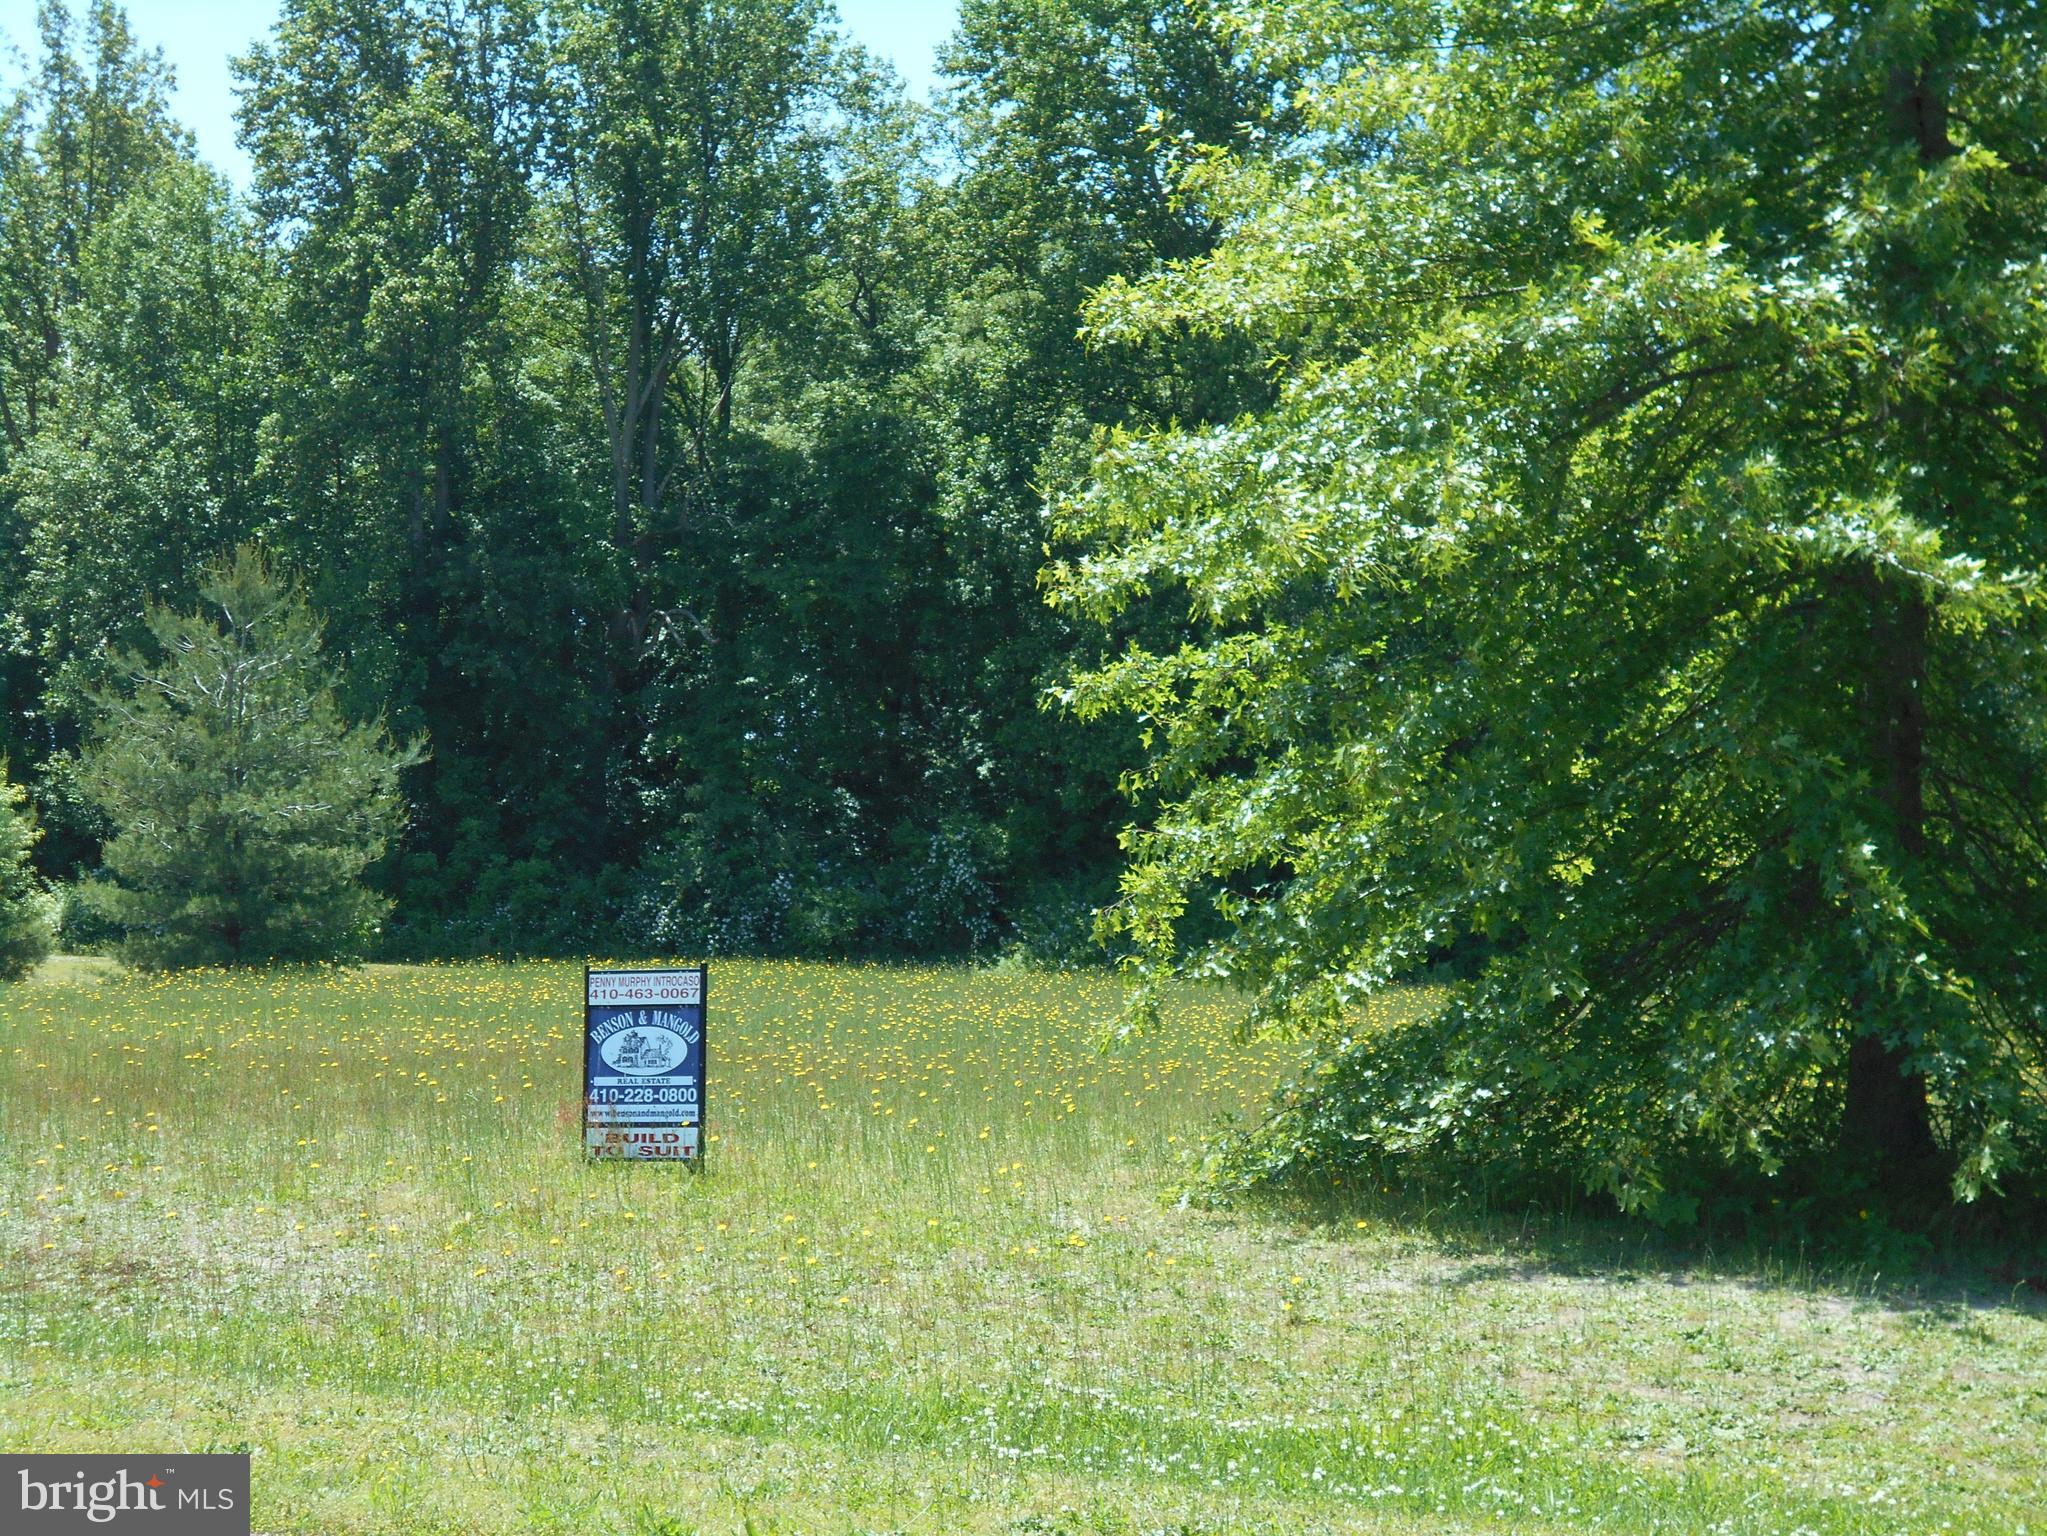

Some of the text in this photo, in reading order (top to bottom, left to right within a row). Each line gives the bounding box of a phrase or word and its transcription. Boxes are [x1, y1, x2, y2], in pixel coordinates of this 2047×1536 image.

[590, 975, 700, 988] PENNY MURPHY INTROCASO
[590, 988, 699, 999] 410-463-0067
[590, 1010, 700, 1044] BENSON & MANGOLD
[590, 1088, 697, 1102] 410-228-0800
[590, 1109, 695, 1118] wwwensonandmangold.com
[605, 1133, 679, 1143] BUILD
[638, 1146, 695, 1156] SUIT
